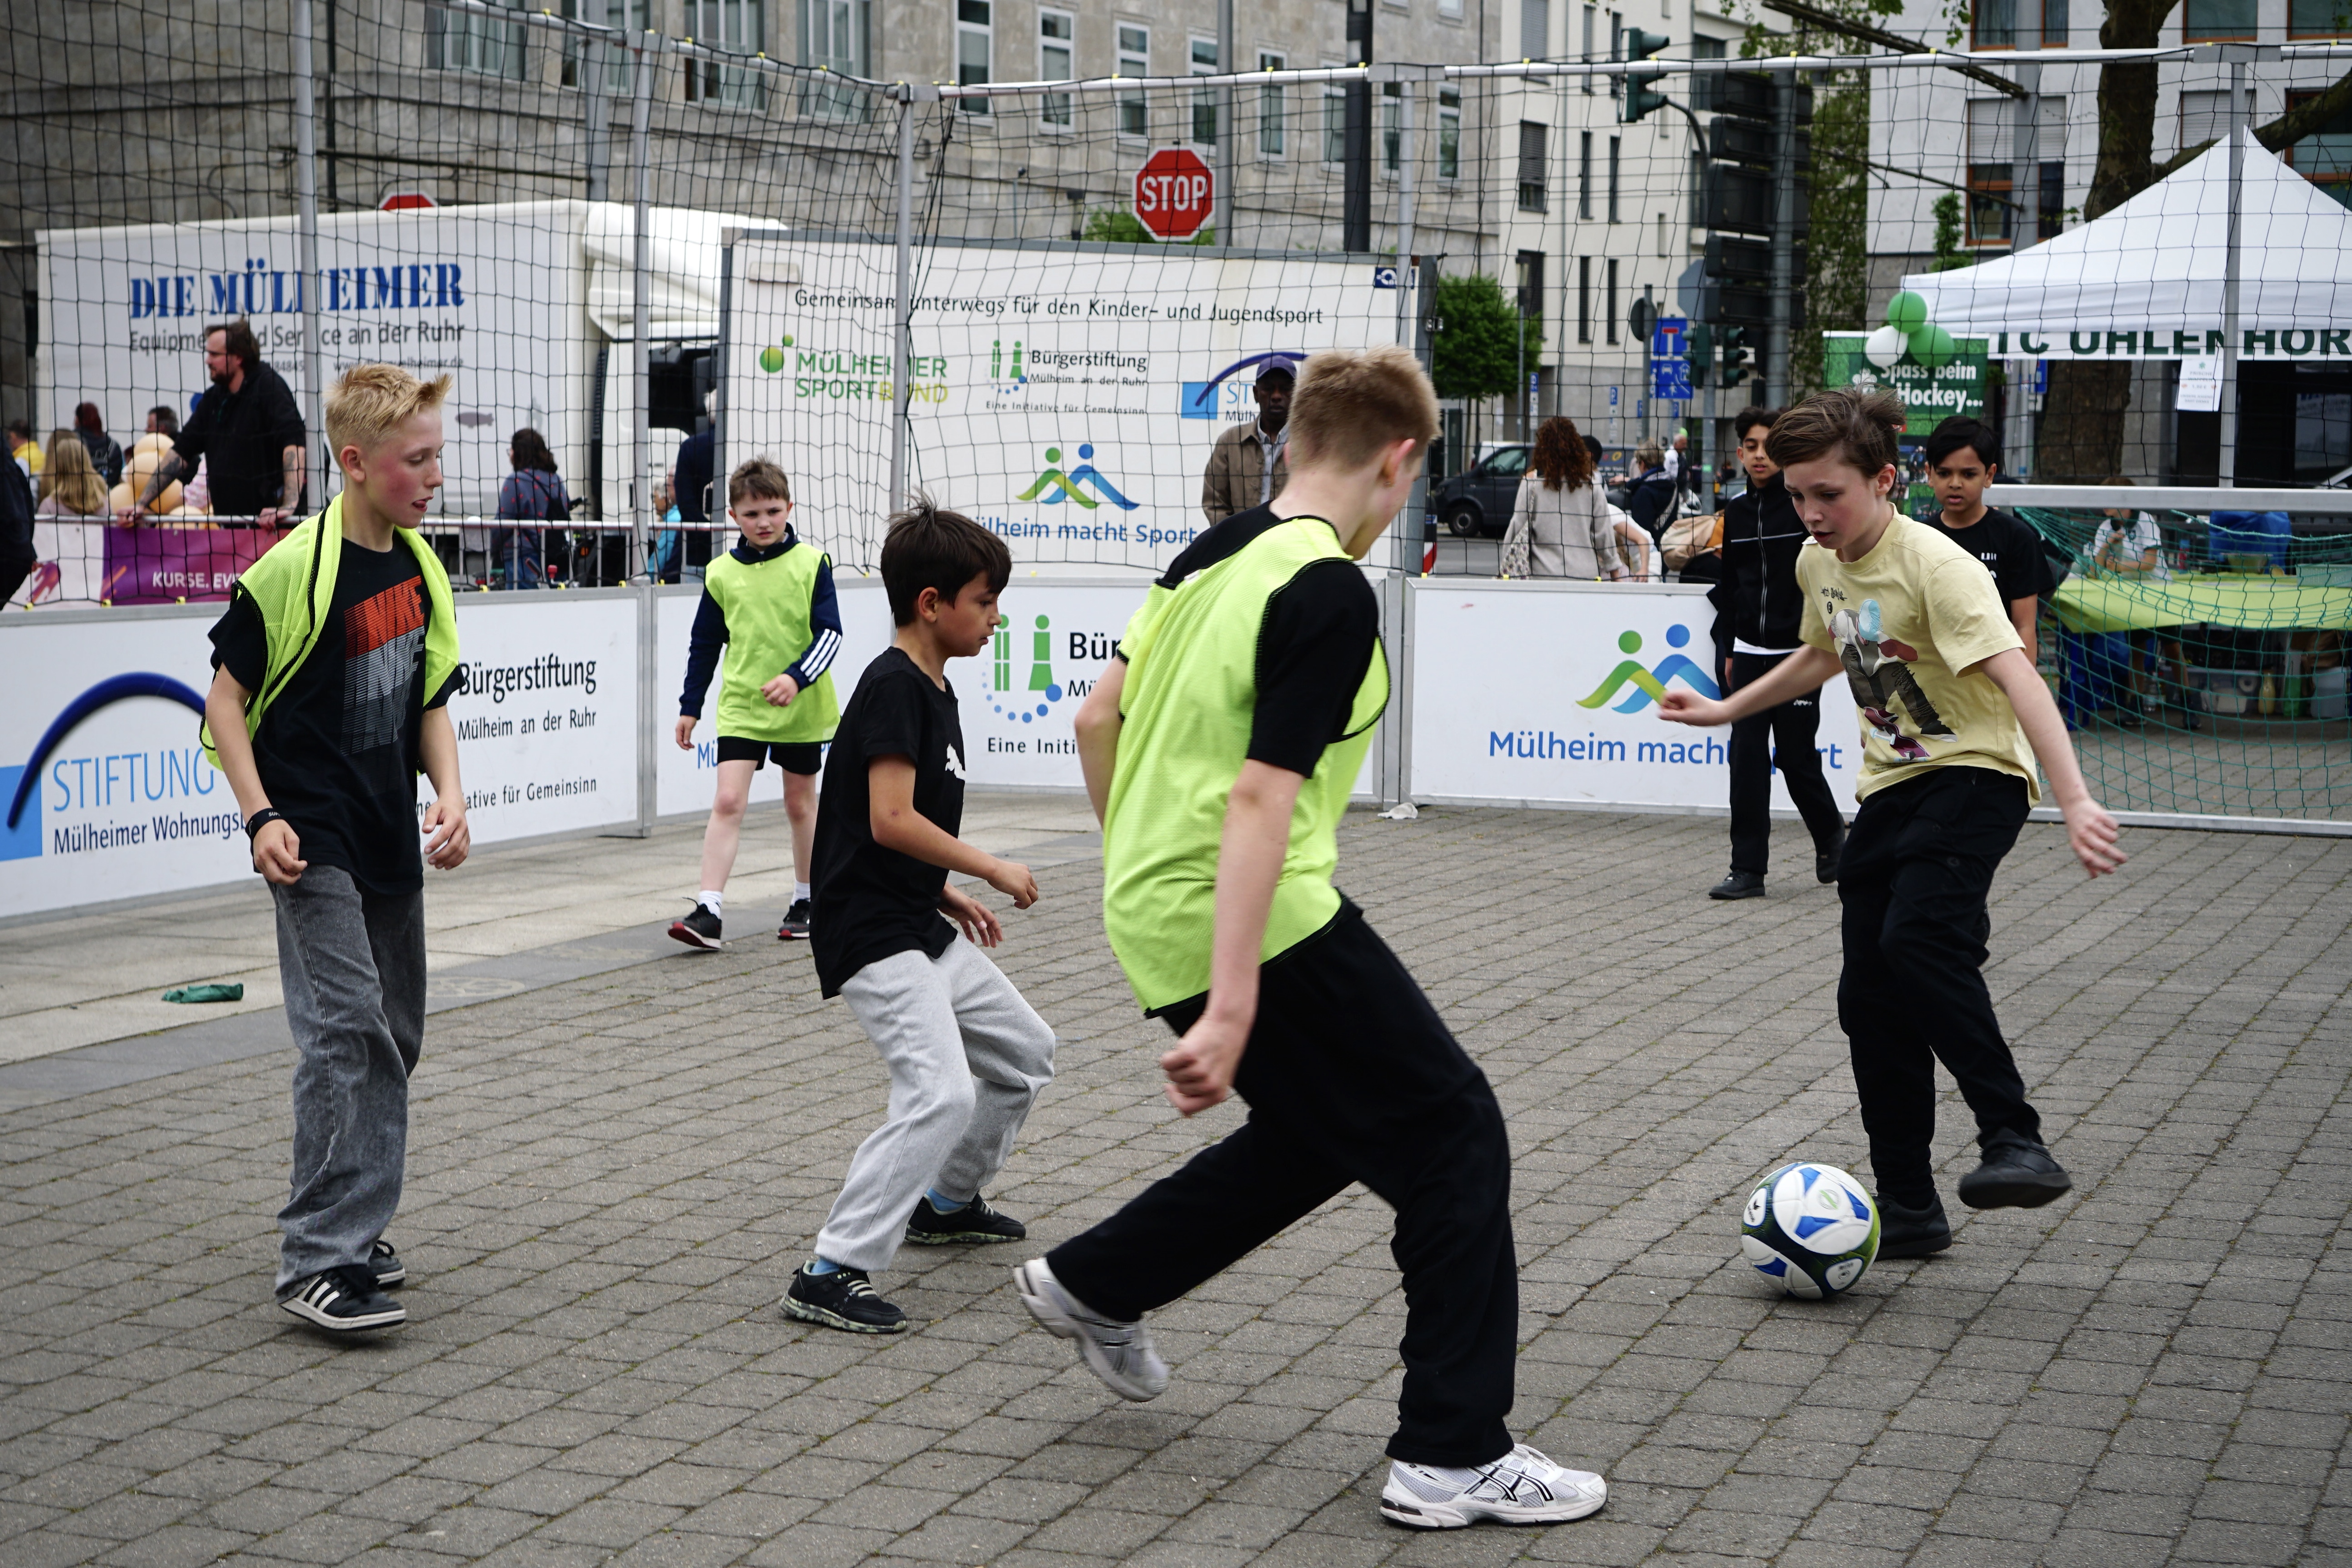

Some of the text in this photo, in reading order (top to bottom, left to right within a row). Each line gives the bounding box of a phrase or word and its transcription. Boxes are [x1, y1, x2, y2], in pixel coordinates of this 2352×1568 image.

[1141, 175, 1207, 211] STOP
[130, 276, 195, 318] DIE
[910, 295, 1004, 317] unterwegs
[1013, 296, 1040, 314] für
[1048, 298, 1079, 315] den
[1090, 299, 1159, 318] Kinder-
[1167, 303, 1201, 320] und
[1209, 303, 1323, 327] Jugendsport
[273, 325, 341, 347] Serce
[349, 328, 370, 345] an
[378, 321, 409, 343] der
[419, 318, 464, 343] Ruhr
[2070, 330, 2352, 355] UHLENHOR
[1031, 350, 1147, 372] Bürgerstiftung
[795, 378, 948, 404] SPORTBND
[1030, 374, 1074, 385] Mülheim
[1099, 376, 1117, 385] der
[1122, 377, 1147, 386] Ruhr
[986, 401, 1145, 415] Eine Initiative für Gemeinsinn
[1058, 522, 1127, 541] macht
[1136, 524, 1197, 548] Sport
[152, 571, 209, 588] KURSE.
[459, 653, 596, 704] Bürgerstiftung
[458, 706, 596, 741] Mülheim an der Ruhr
[988, 738, 1075, 754] Eine Initi
[1490, 730, 1625, 761] Mülheim
[53, 747, 214, 812] STIFTUNG
[463, 790, 496, 809] ative
[503, 785, 520, 804] für
[527, 776, 596, 801] Gemeinsinn
[54, 820, 147, 854] Mülheimer
